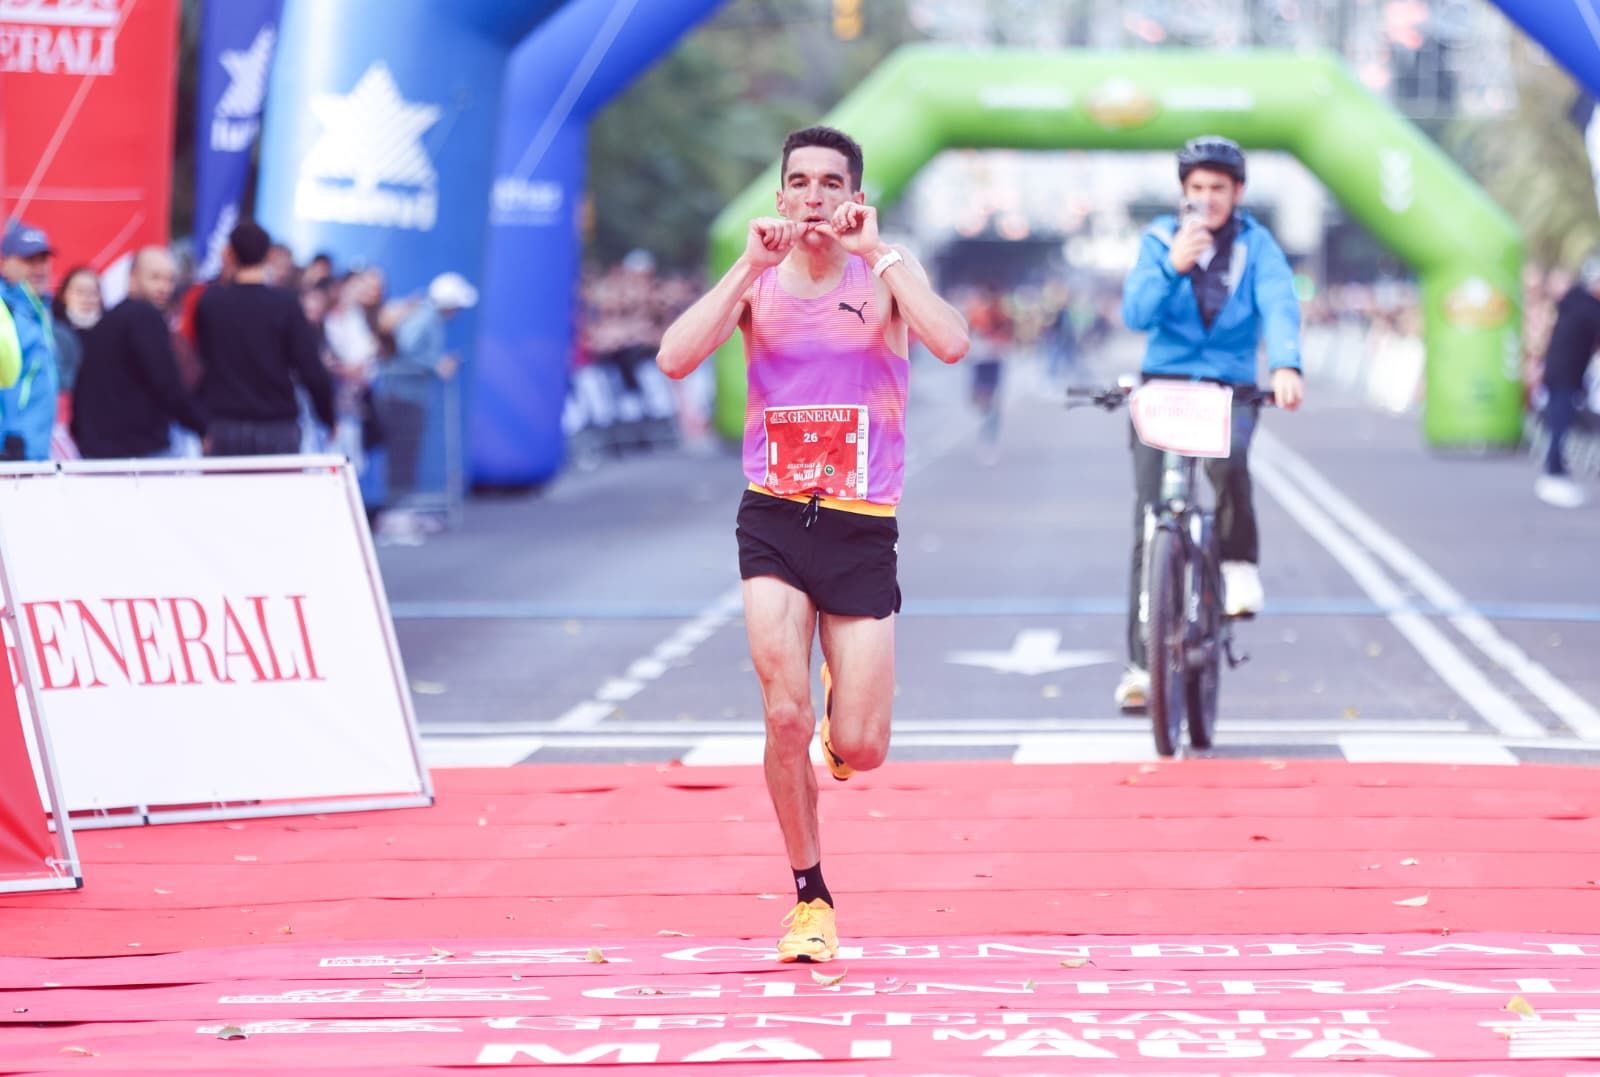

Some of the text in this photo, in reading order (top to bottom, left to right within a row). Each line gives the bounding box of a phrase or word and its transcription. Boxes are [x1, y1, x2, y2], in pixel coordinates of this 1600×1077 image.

[788, 409, 851, 423] GENERALI
[803, 432, 818, 443] 26
[3, 594, 326, 691] ENERALI
[484, 1009, 1390, 1030] GENERALI
